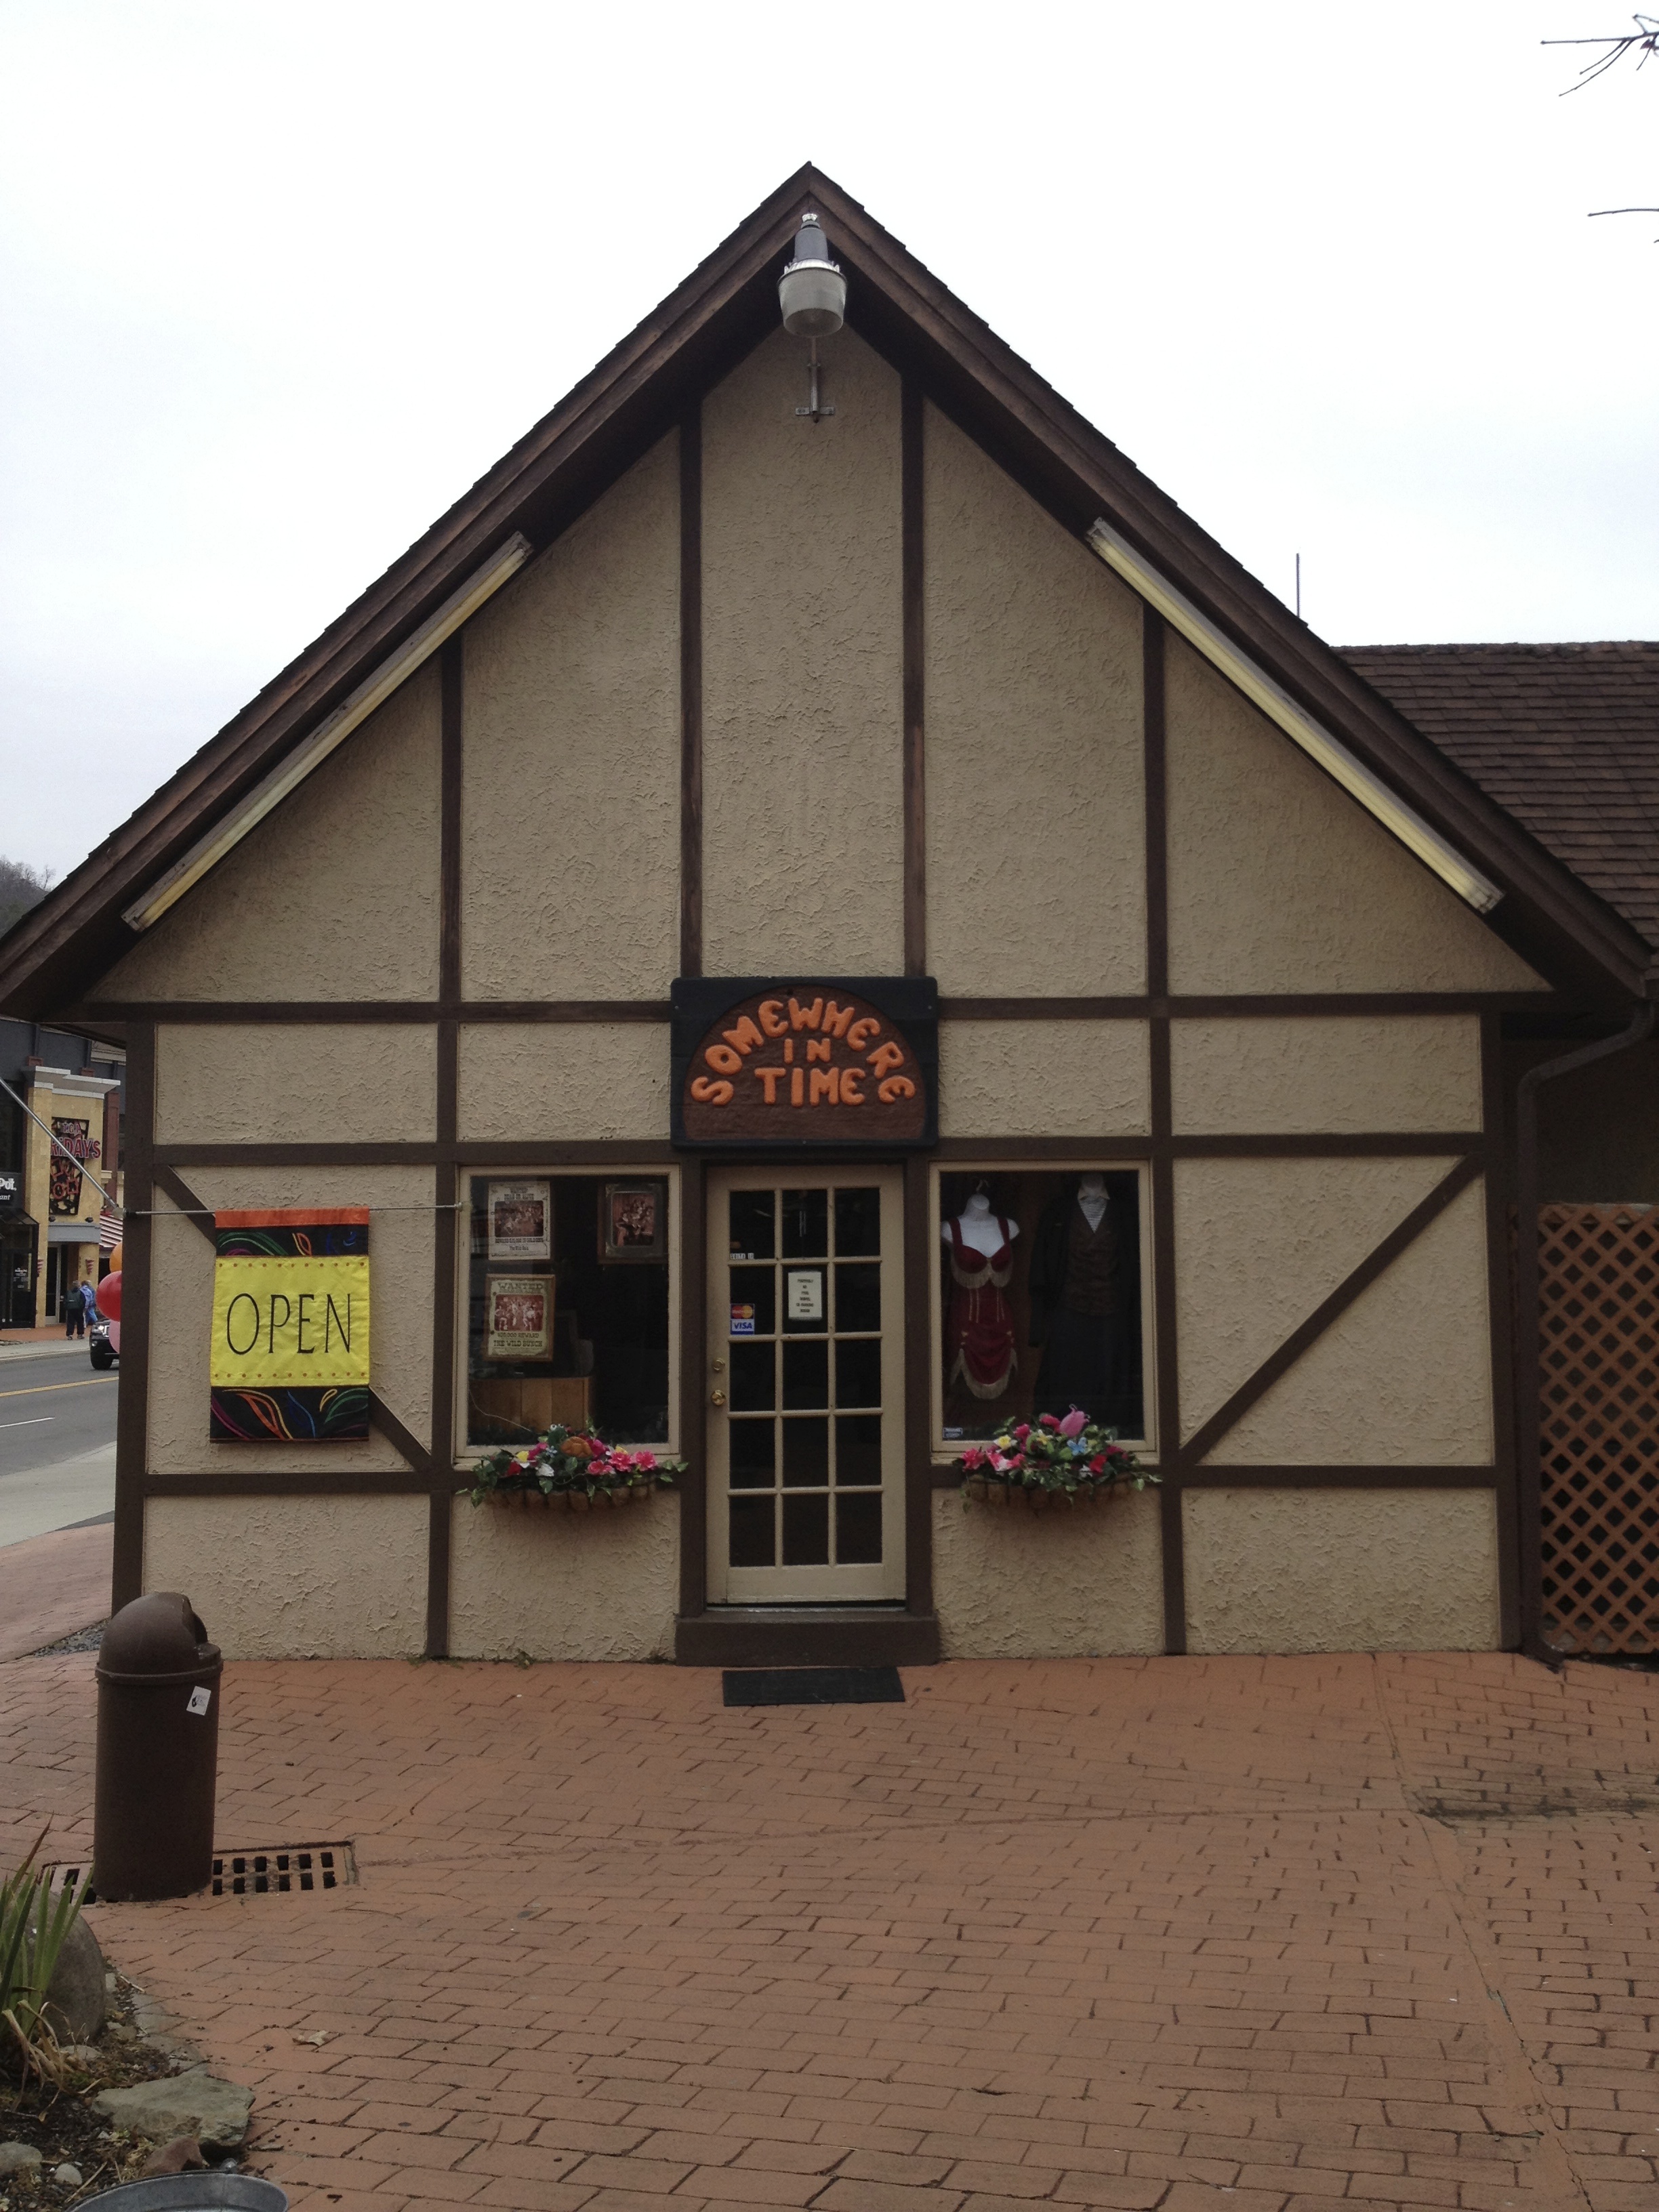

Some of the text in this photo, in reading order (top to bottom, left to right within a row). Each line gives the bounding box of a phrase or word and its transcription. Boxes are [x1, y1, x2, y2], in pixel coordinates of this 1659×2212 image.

[690, 998, 916, 1106] SOMEWHERE
[783, 1038, 832, 1064] IN
[754, 1067, 866, 1107] TIME
[226, 1292, 351, 1355] OPEN
